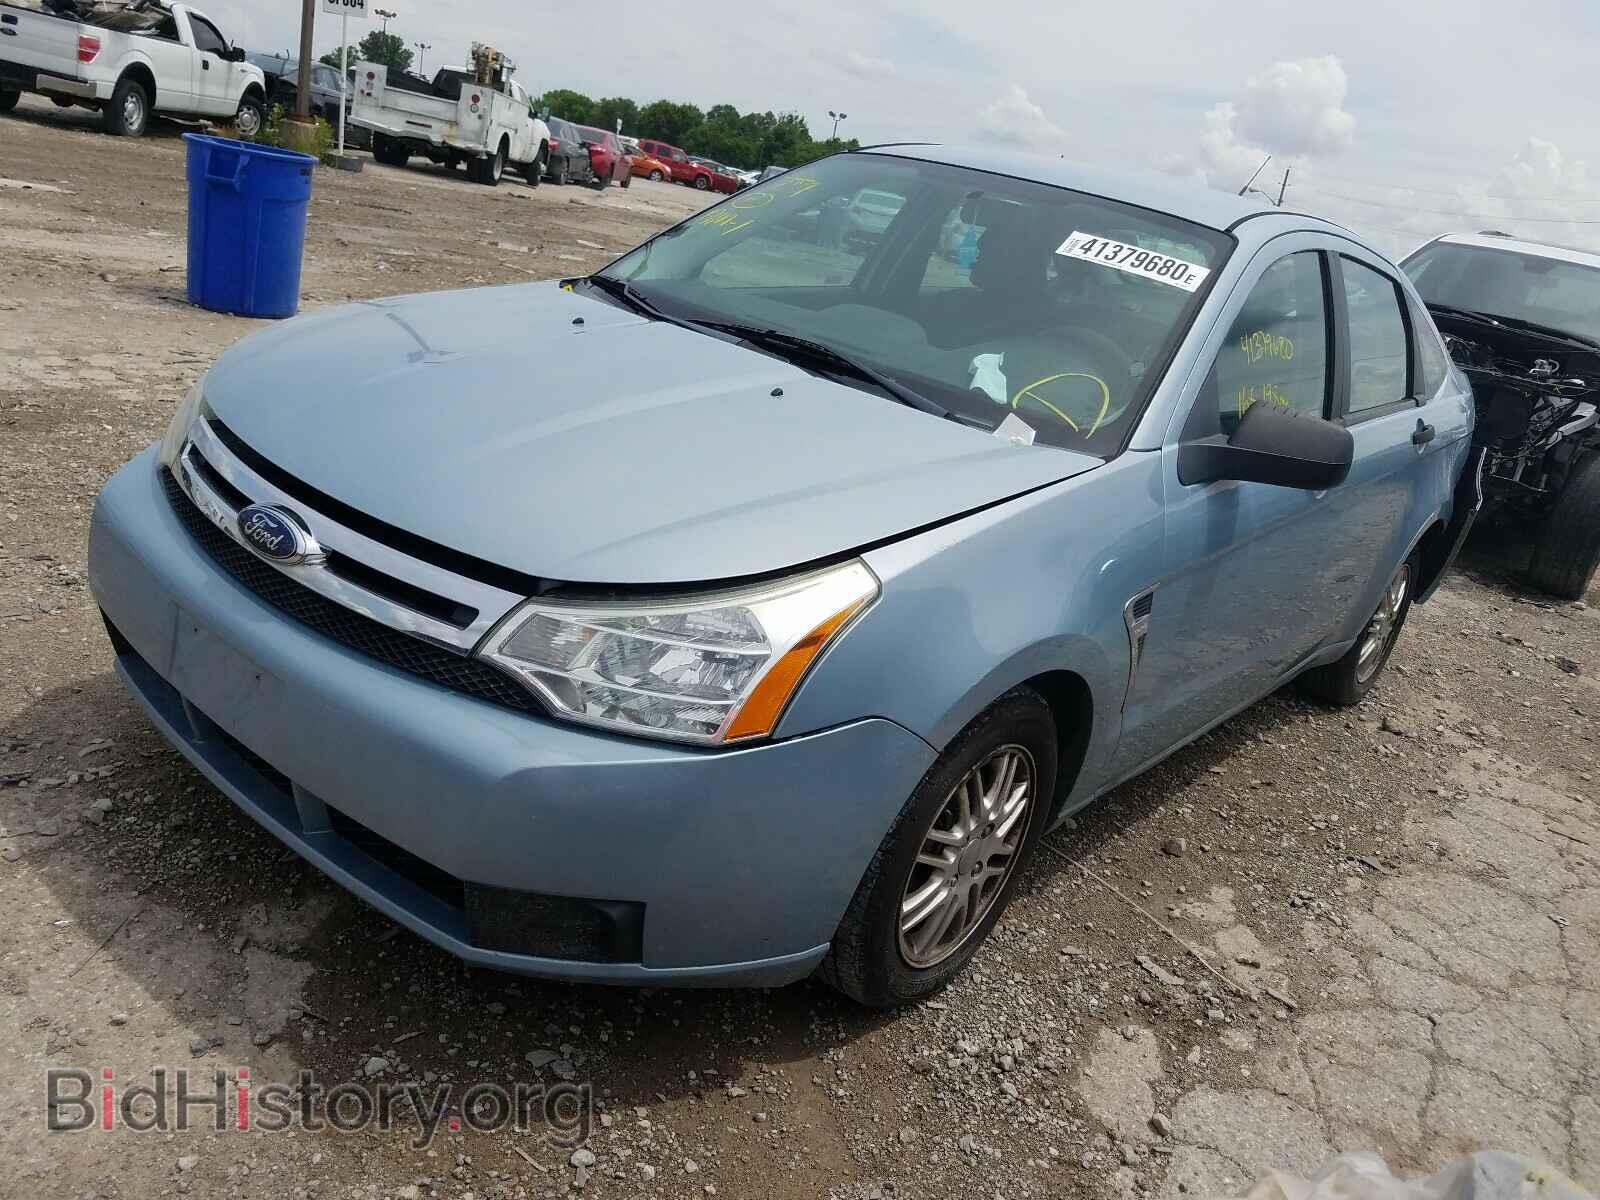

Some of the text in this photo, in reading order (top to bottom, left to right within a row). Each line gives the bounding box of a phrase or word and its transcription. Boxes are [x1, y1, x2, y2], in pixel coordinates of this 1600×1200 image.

[1079, 238, 1189, 282] 41379680
[1183, 273, 1197, 285] E
[244, 513, 285, 551] Ford
